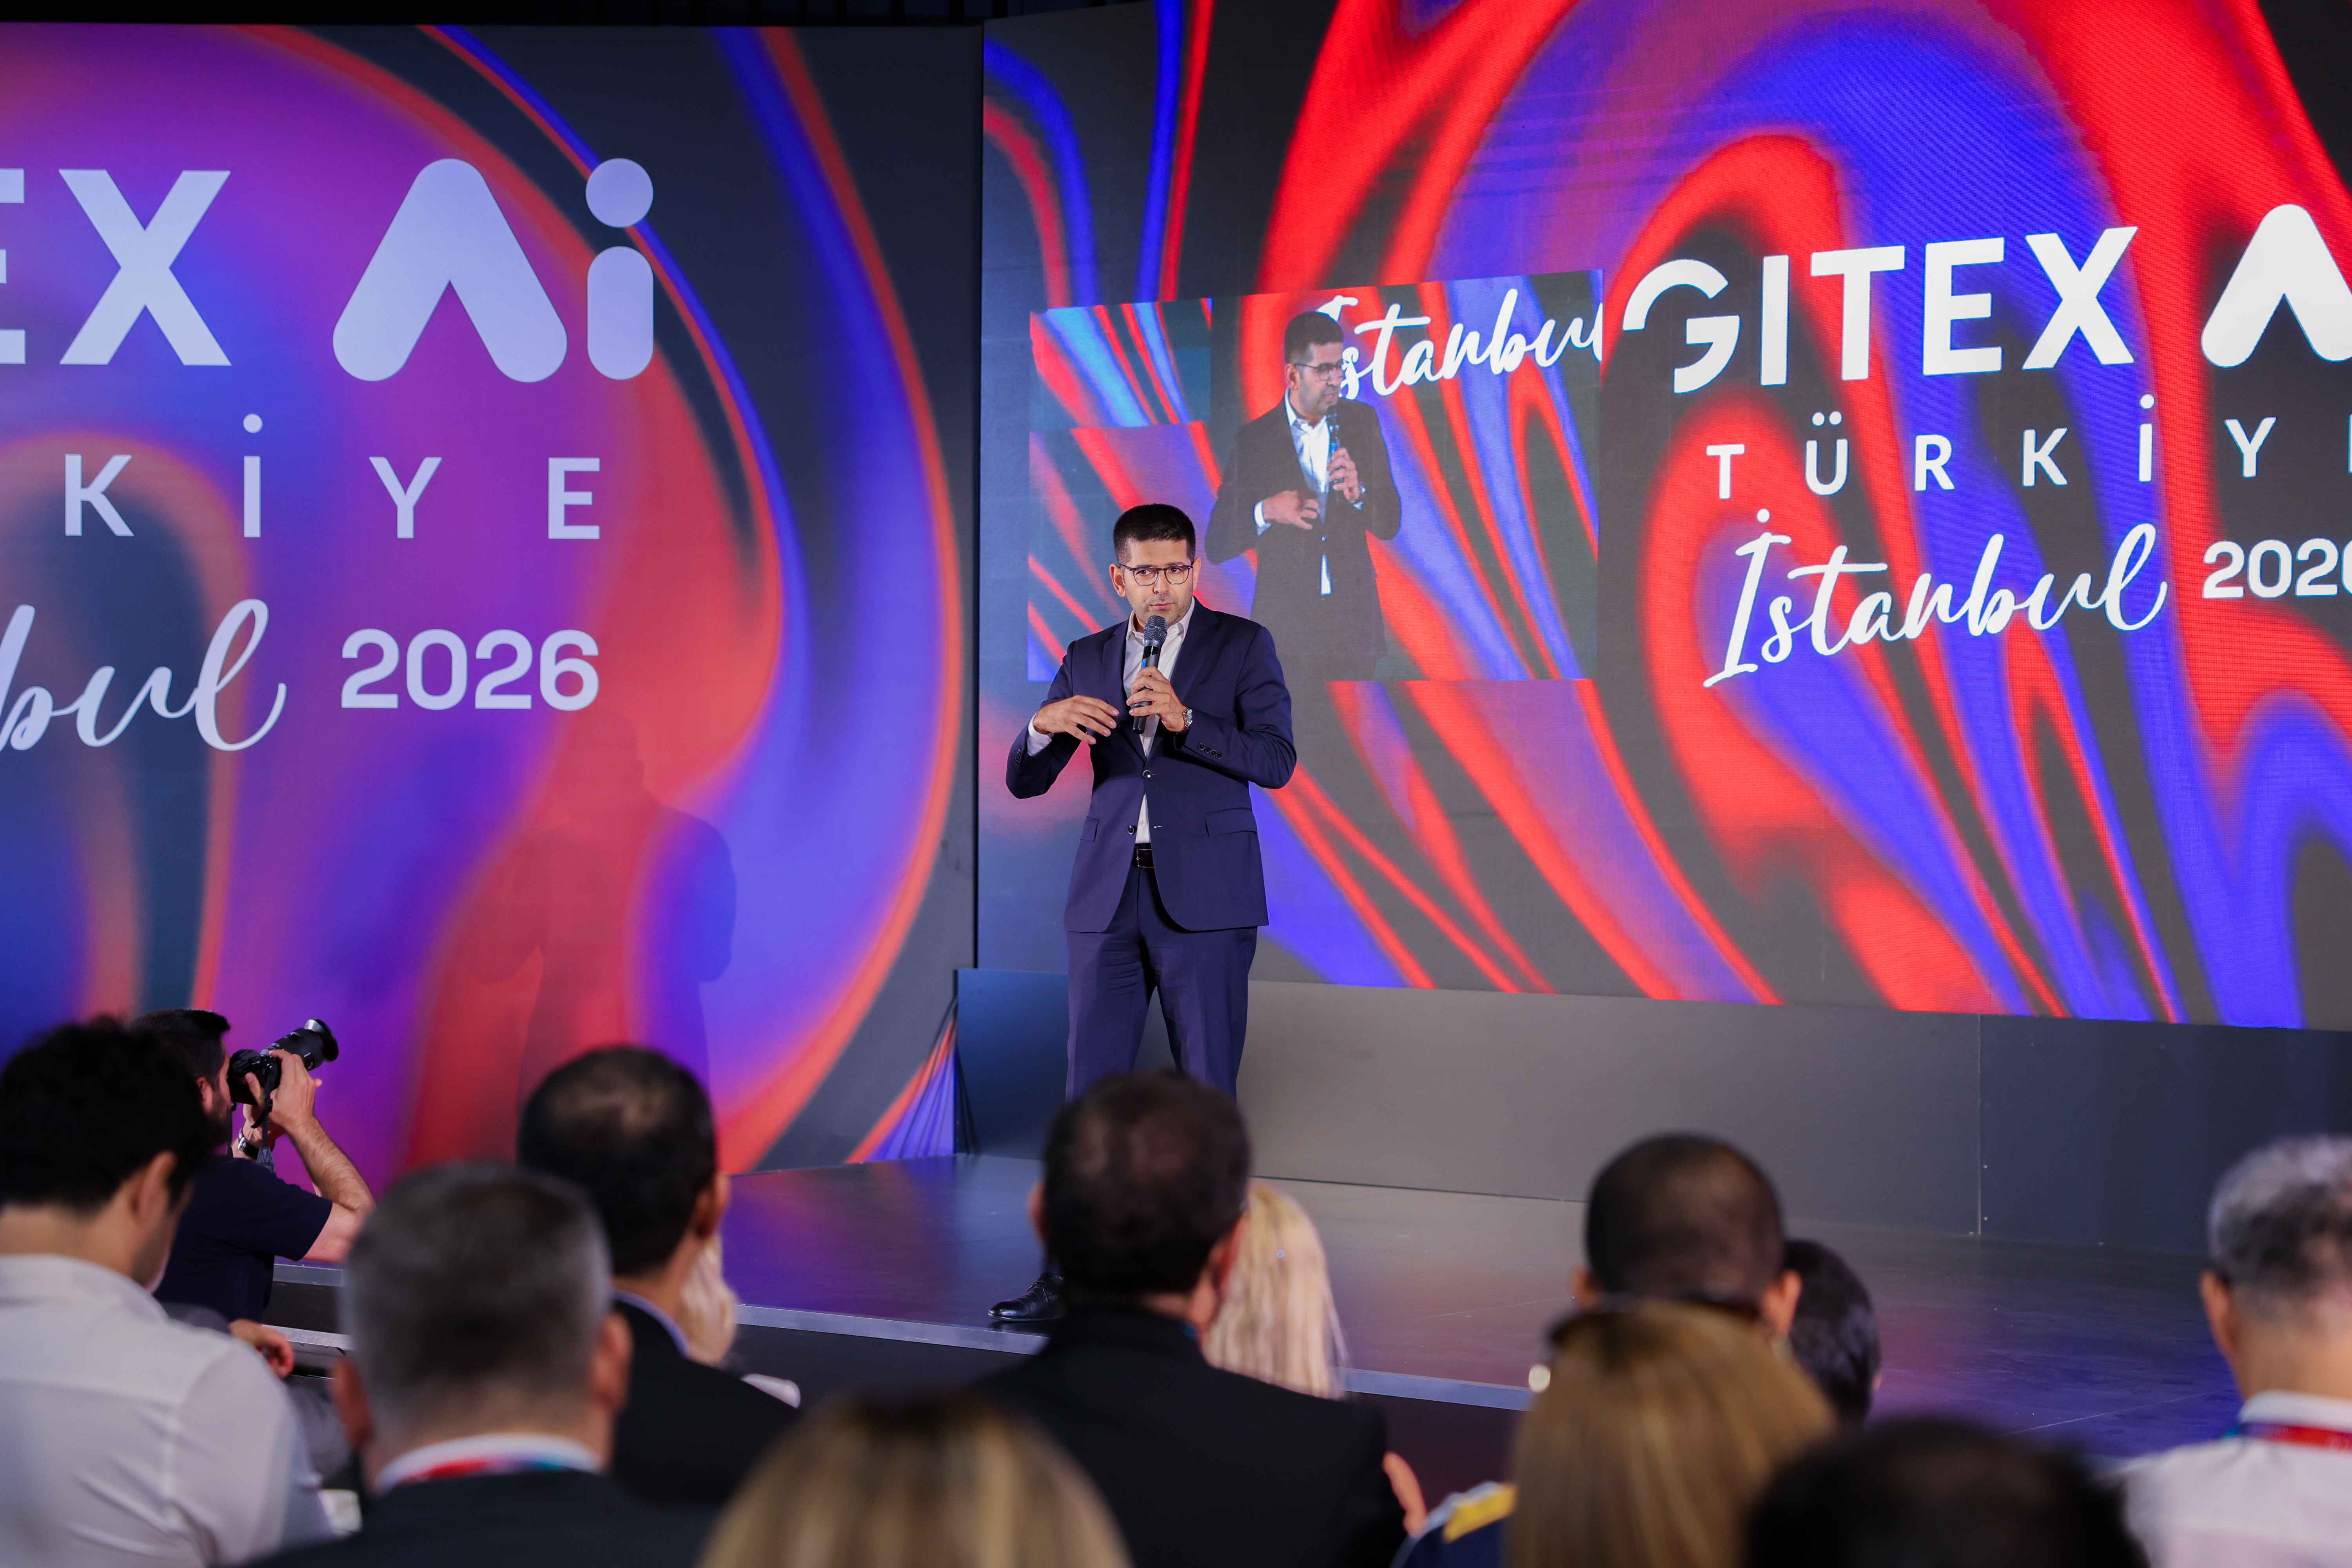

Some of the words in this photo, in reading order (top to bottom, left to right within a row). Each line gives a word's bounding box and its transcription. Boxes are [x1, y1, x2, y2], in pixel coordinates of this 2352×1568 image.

[0, 169, 232, 366] X
[332, 158, 654, 383] Ai
[1316, 288, 1603, 400] stanbu
[1622, 225, 2139, 393] GITEX
[64, 413, 600, 539] KİYE
[1706, 394, 2352, 499] TÜRKİY
[1703, 508, 2168, 687] İstanbul
[2203, 537, 2352, 599] 202
[0, 598, 287, 751] bul
[341, 628, 599, 711] 2026
